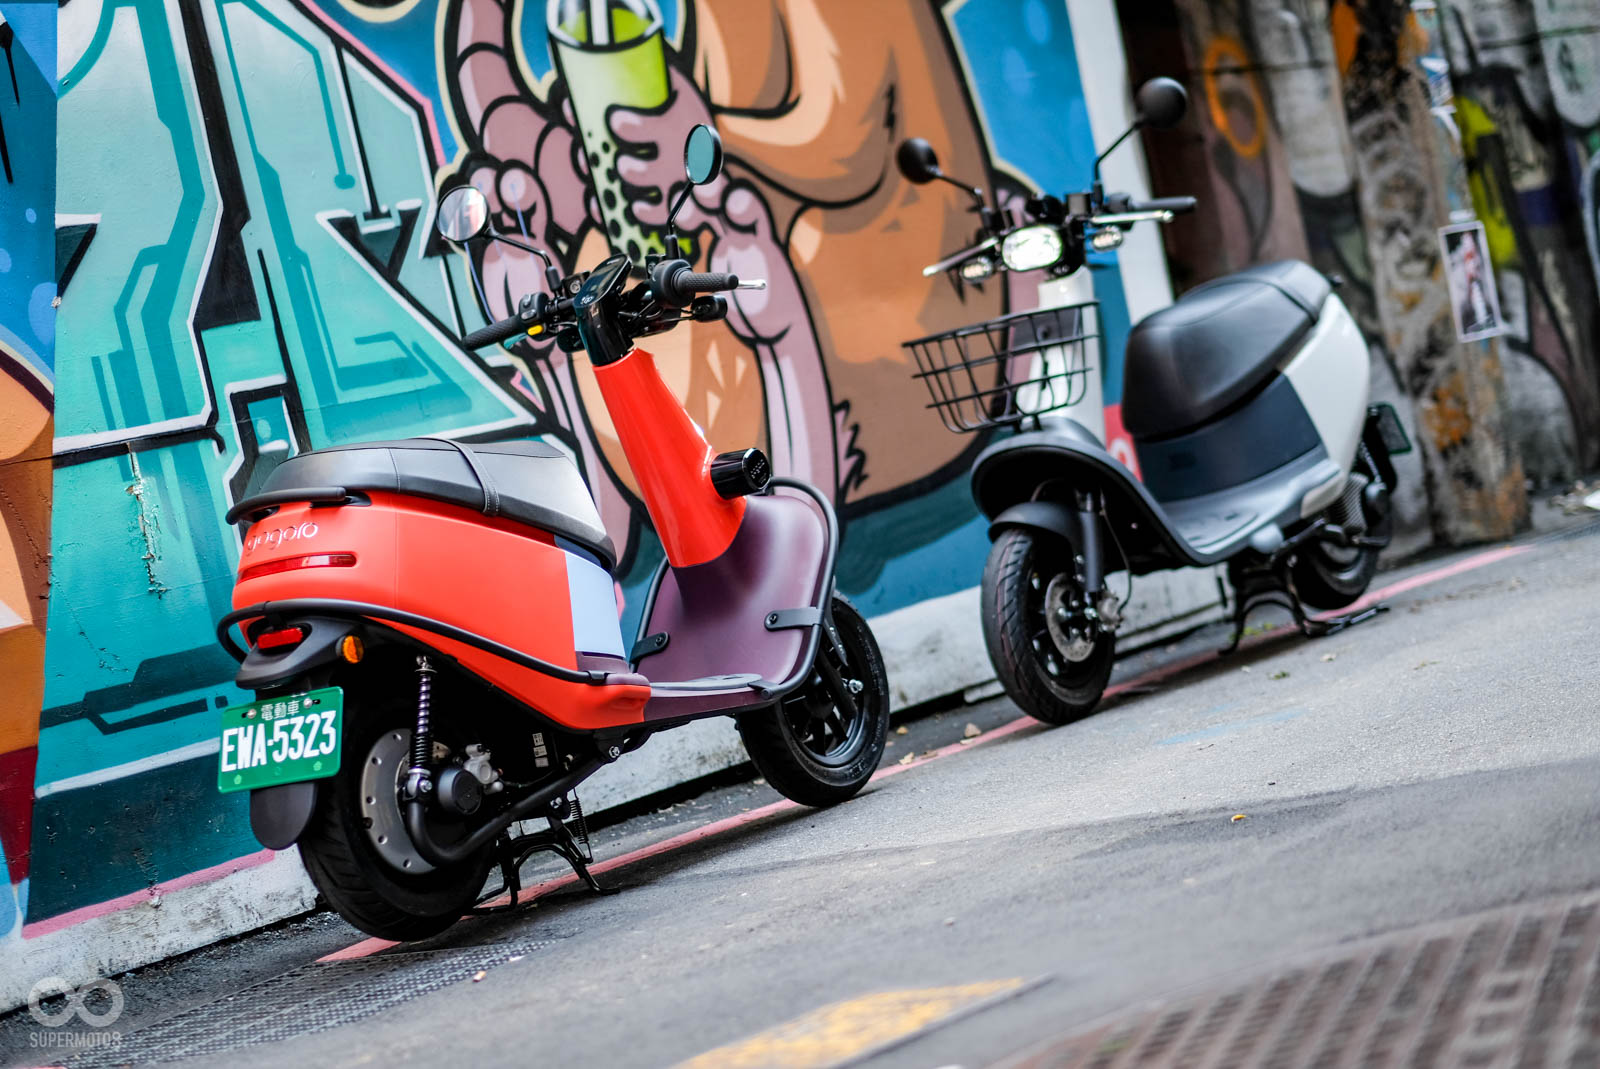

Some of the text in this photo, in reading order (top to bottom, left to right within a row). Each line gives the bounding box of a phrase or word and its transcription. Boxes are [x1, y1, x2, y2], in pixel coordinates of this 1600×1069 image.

[246, 522, 318, 556] gogoro
[261, 700, 300, 721] 電動車
